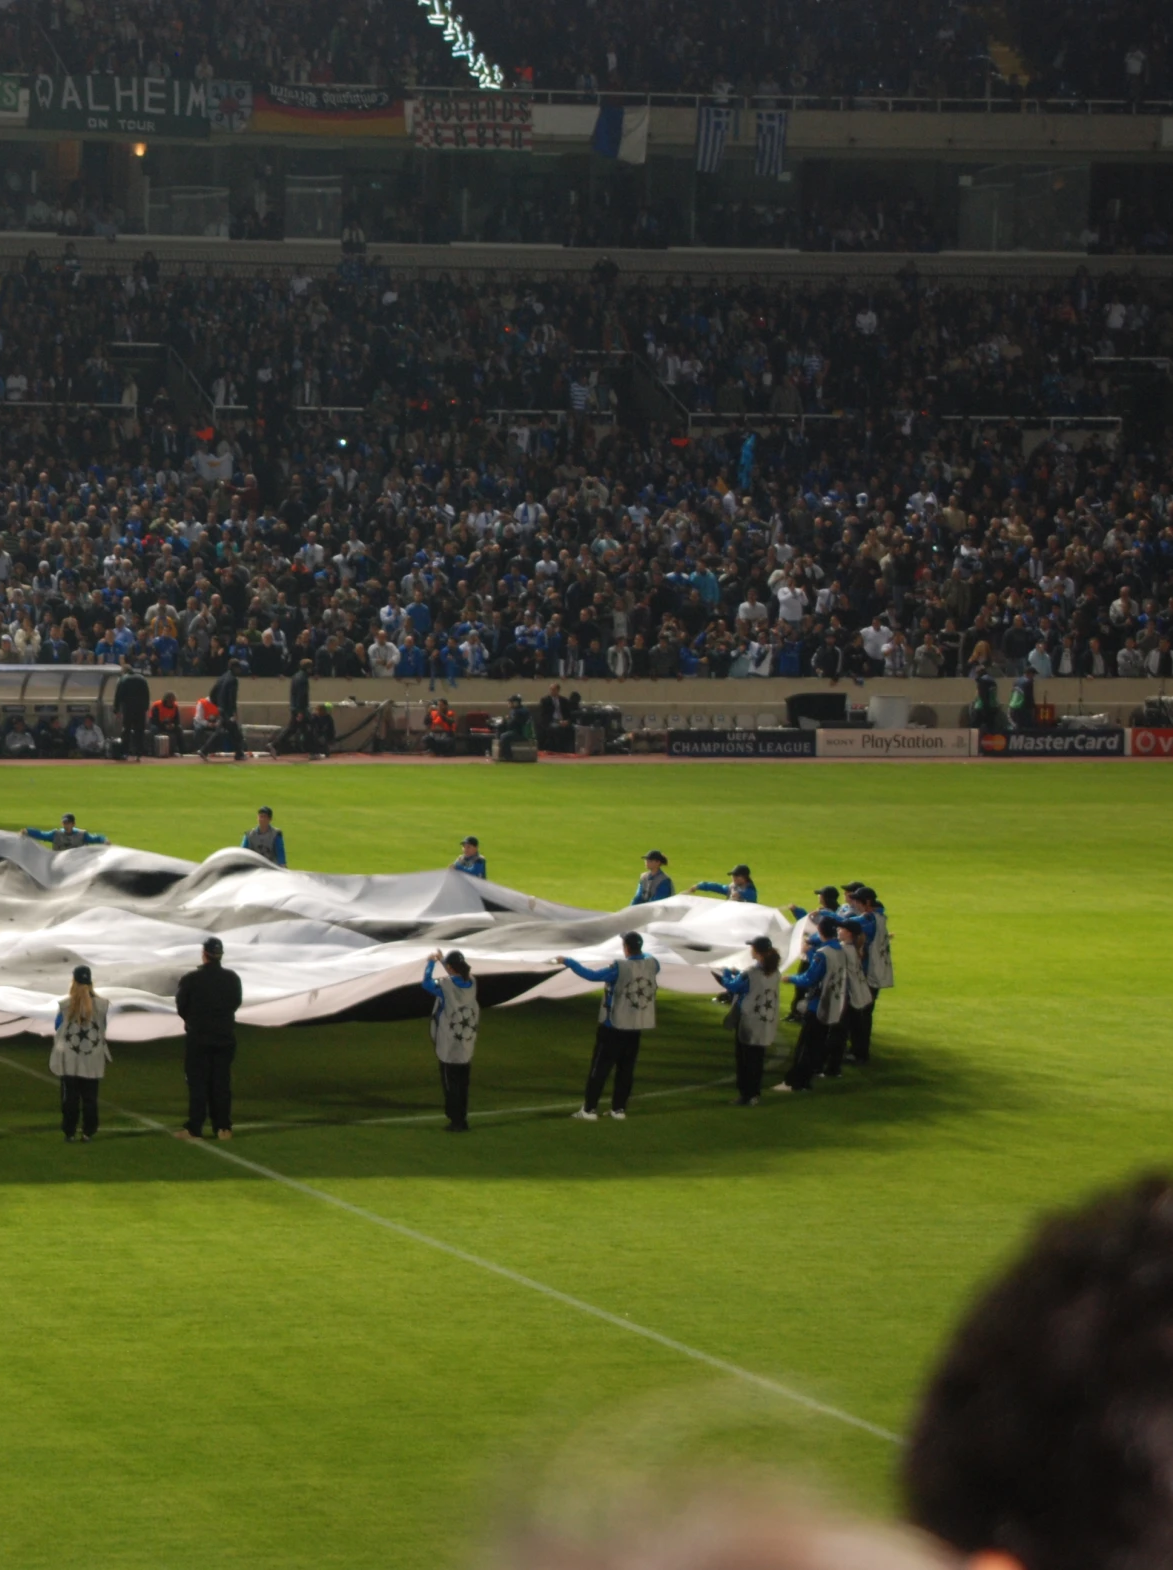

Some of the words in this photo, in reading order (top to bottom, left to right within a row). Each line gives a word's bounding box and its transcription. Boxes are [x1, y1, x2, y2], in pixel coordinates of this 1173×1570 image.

[34, 73, 207, 118] DALHEIM
[87, 117, 108, 129] ON
[118, 118, 156, 132] TOUR
[727, 733, 756, 741] UEFA
[861, 733, 944, 753] PlayStation
[1008, 733, 1120, 751] MasterCard
[672, 741, 754, 753] CHAMPIONS
[758, 741, 812, 753] LEAGUE
